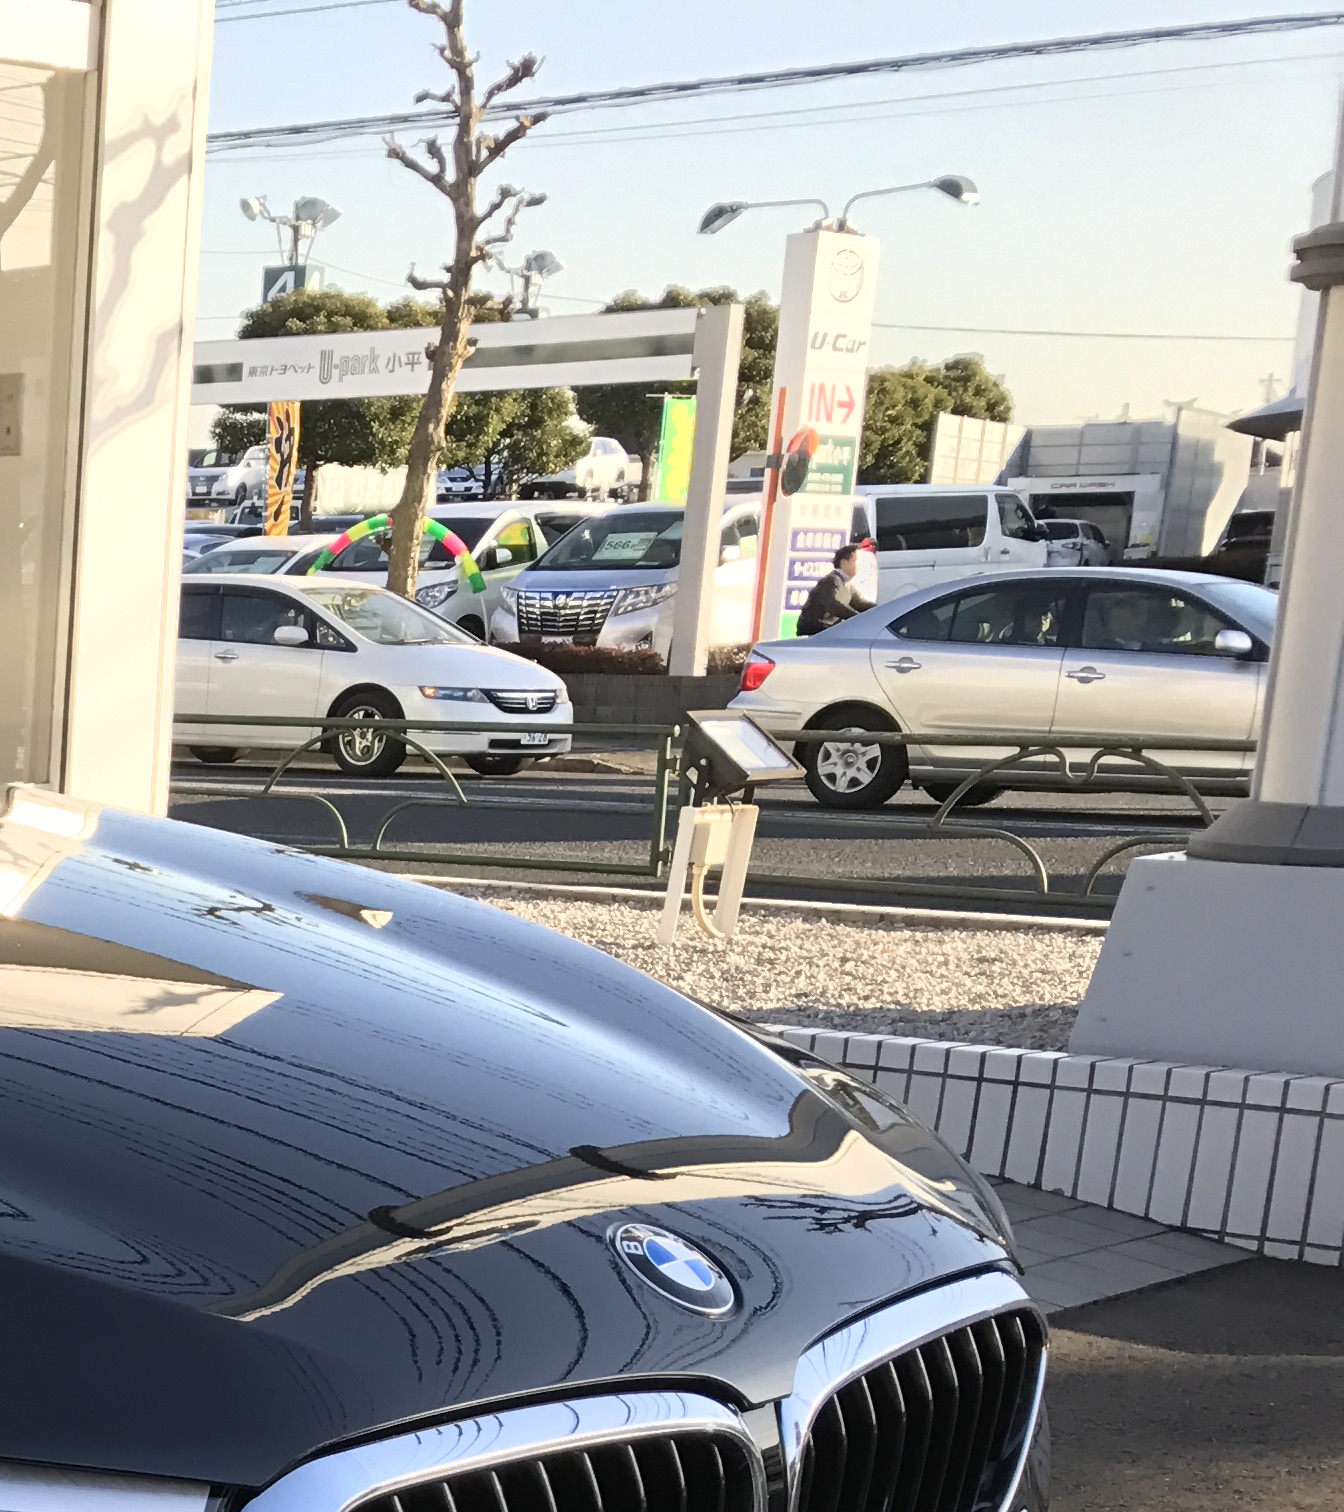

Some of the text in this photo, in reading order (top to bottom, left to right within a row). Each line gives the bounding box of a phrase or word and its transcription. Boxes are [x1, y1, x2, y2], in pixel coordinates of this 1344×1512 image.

[810, 331, 866, 353] U-Car
[247, 362, 315, 378] 東京トヨペット
[385, 351, 423, 373] 小平
[808, 382, 837, 424] IN
